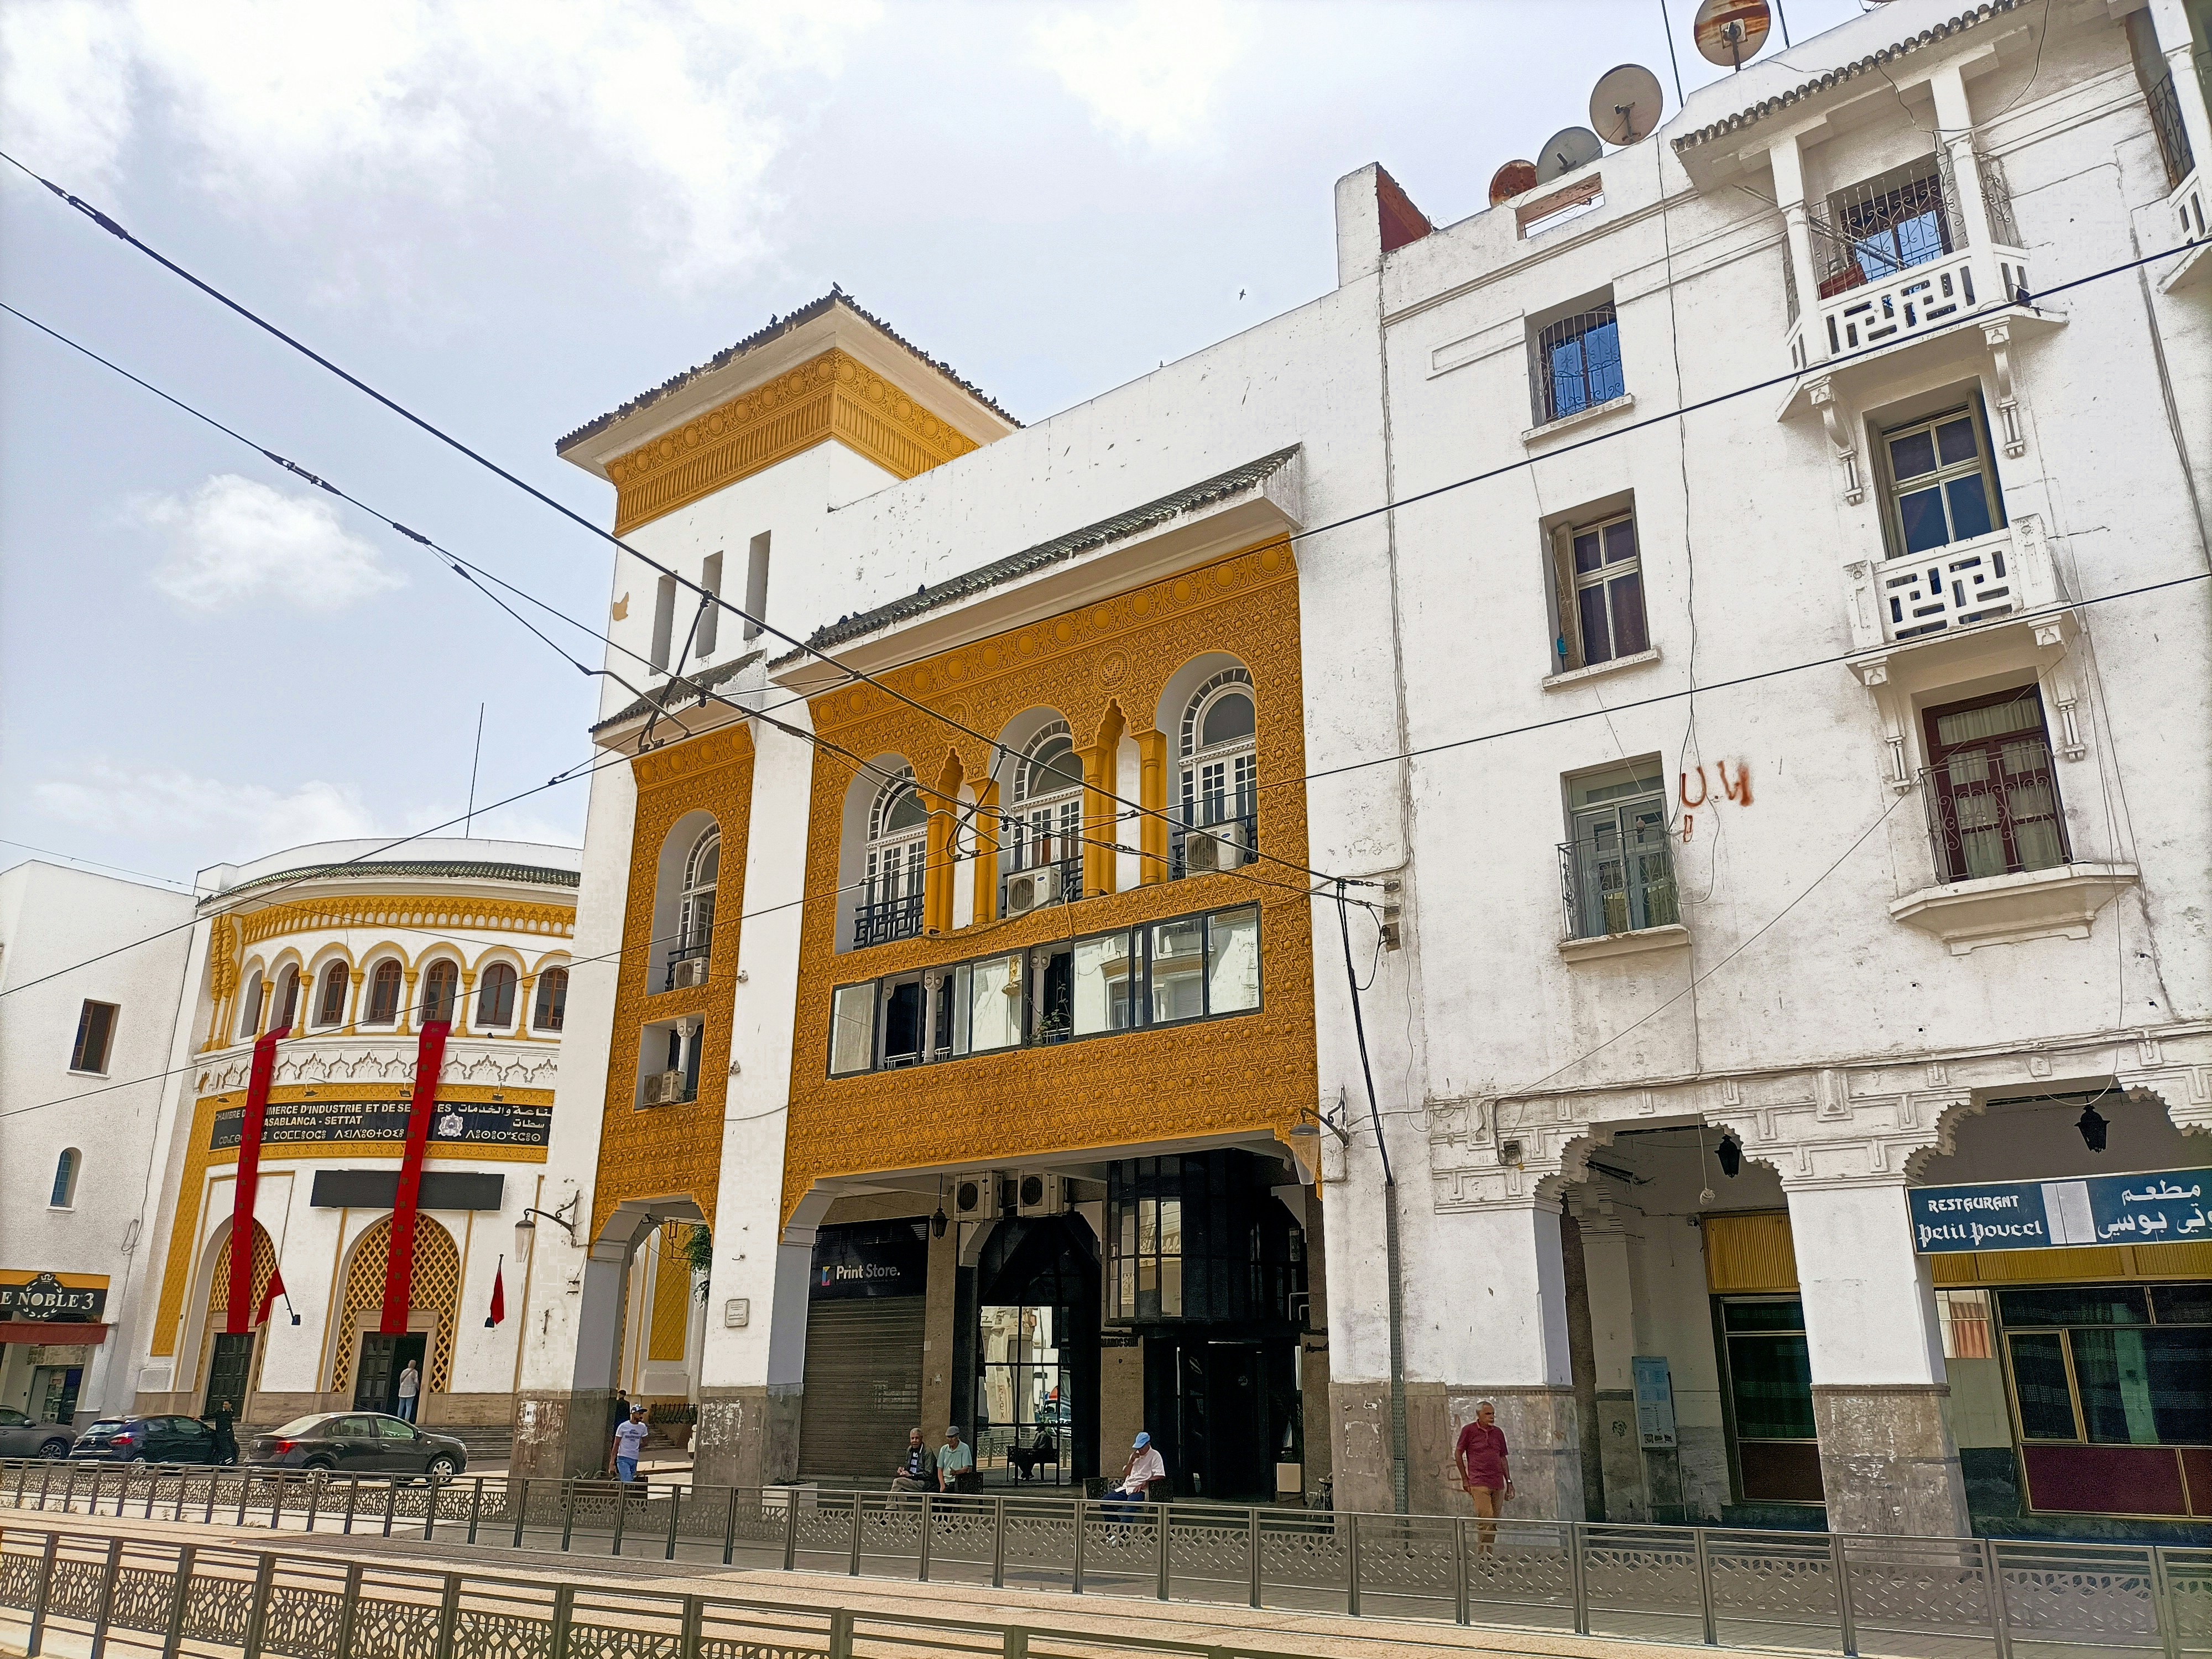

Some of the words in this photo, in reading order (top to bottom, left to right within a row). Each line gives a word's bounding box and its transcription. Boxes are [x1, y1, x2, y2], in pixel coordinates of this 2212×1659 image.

[300, 1104, 362, 1114] D'INDUSTRIE
[366, 1104, 379, 1113] ET
[382, 1103, 395, 1113] DE
[458, 1103, 511, 1117] والخدمات
[263, 1116, 316, 1127] ASABLANCA
[325, 1115, 363, 1125] SETTAT
[513, 1118, 545, 1129] سطات
[2121, 1179, 2201, 1207] مطعم
[1928, 1195, 2019, 1214] RESTAURANT
[2098, 1211, 2167, 1239] بوسي
[836, 1264, 864, 1280] Print
[865, 1263, 900, 1278] Store.
[17, 1292, 79, 1307] NOBLE
[81, 1292, 95, 1310] 3
